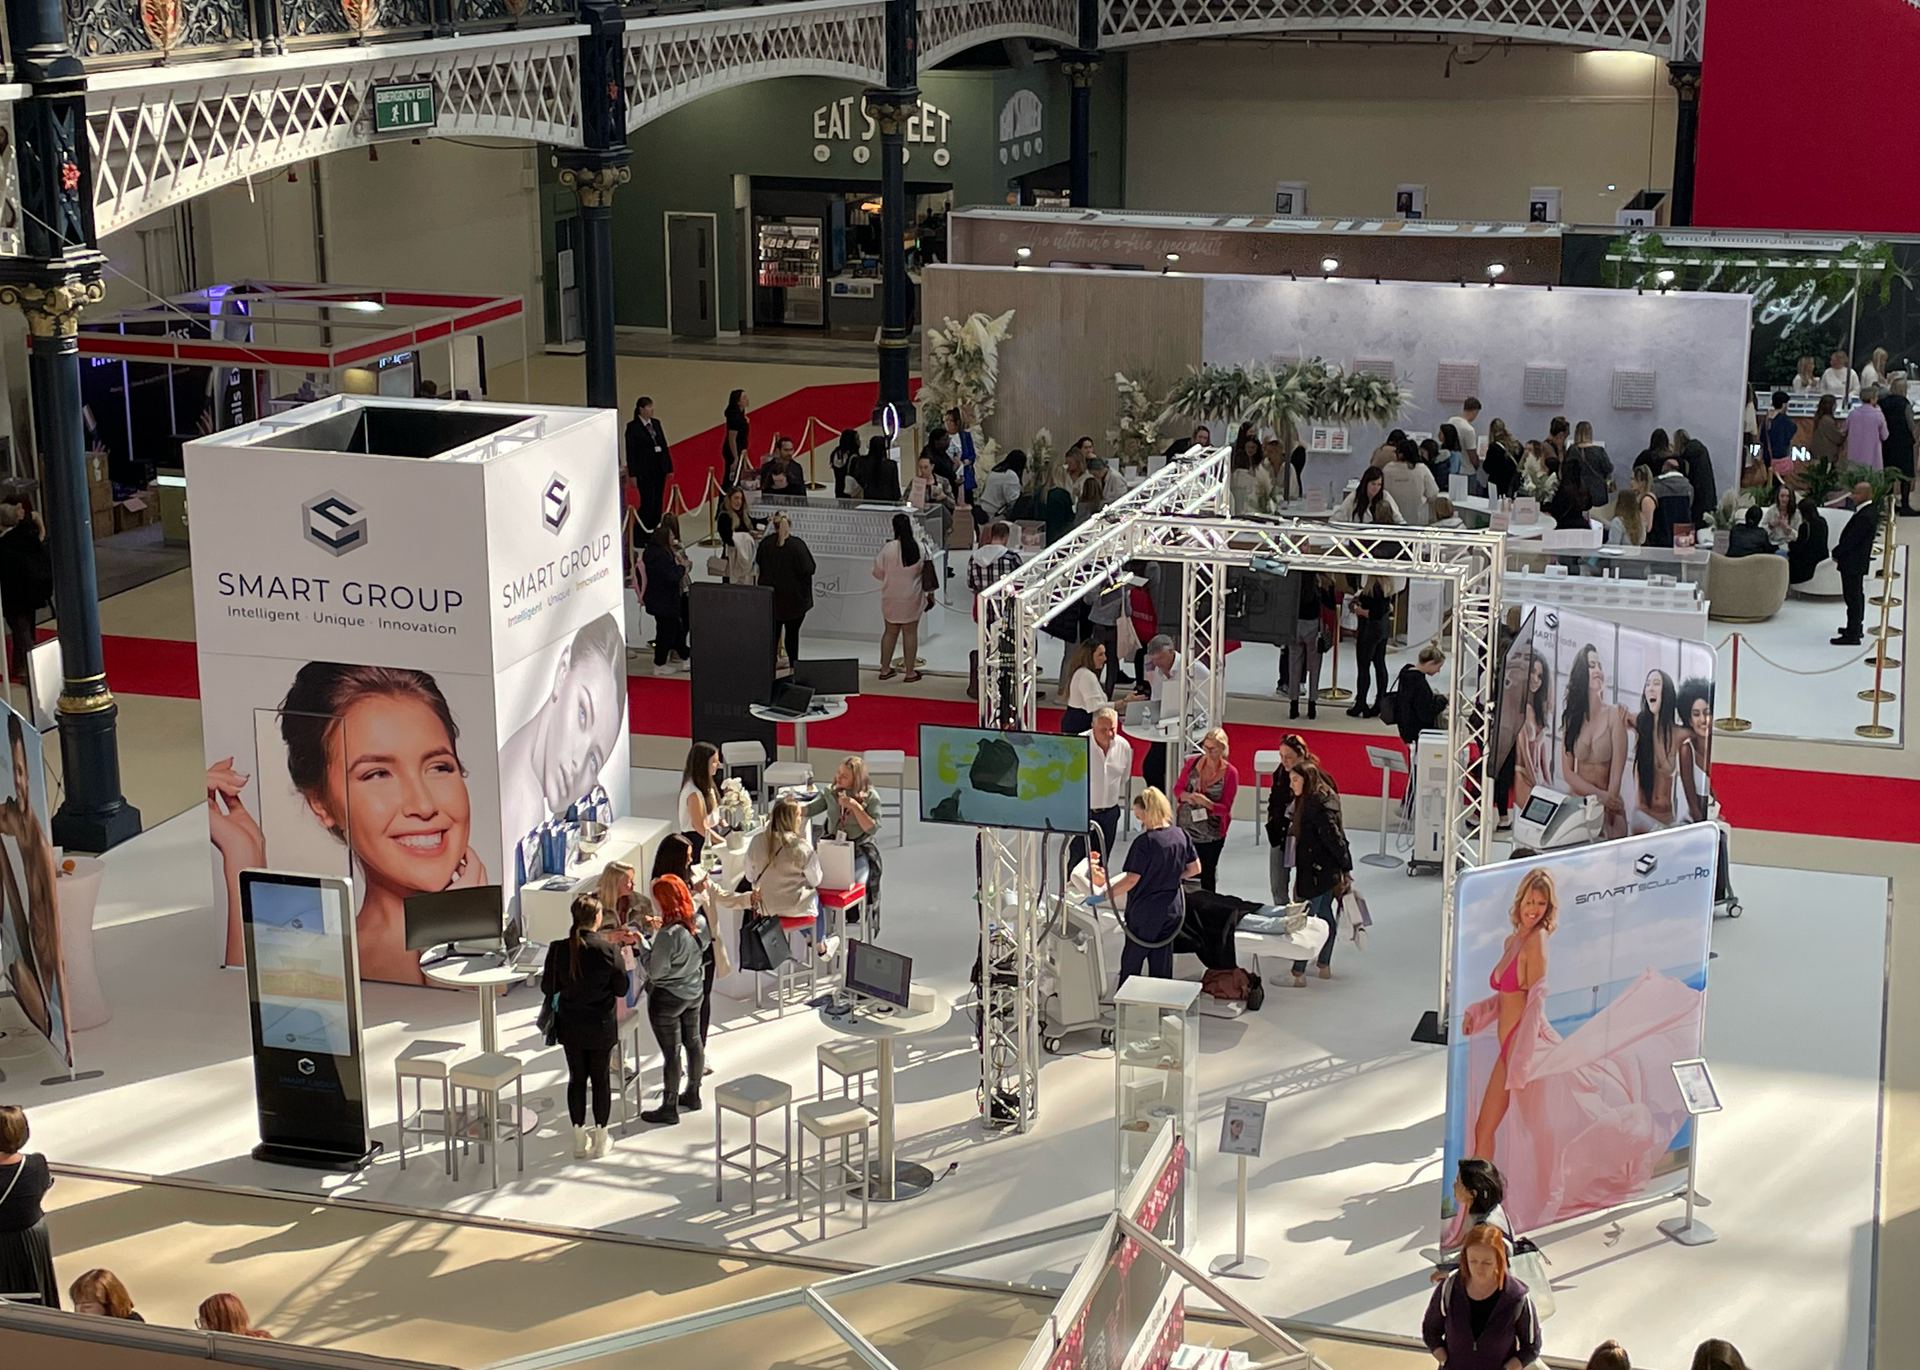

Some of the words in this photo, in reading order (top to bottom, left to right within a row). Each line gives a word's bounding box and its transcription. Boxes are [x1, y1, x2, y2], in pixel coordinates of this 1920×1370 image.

[376, 89, 416, 103] EMERGENCY
[416, 87, 430, 100] EXIT
[813, 96, 854, 139] EAT
[861, 95, 951, 143] SEET
[502, 561, 555, 608] SMART
[560, 534, 611, 578] GROUP
[218, 572, 330, 602] SMART
[342, 582, 462, 613] GROUP
[228, 605, 300, 622] Intelligent
[313, 611, 365, 628] Unique
[378, 617, 457, 635] Innovation
